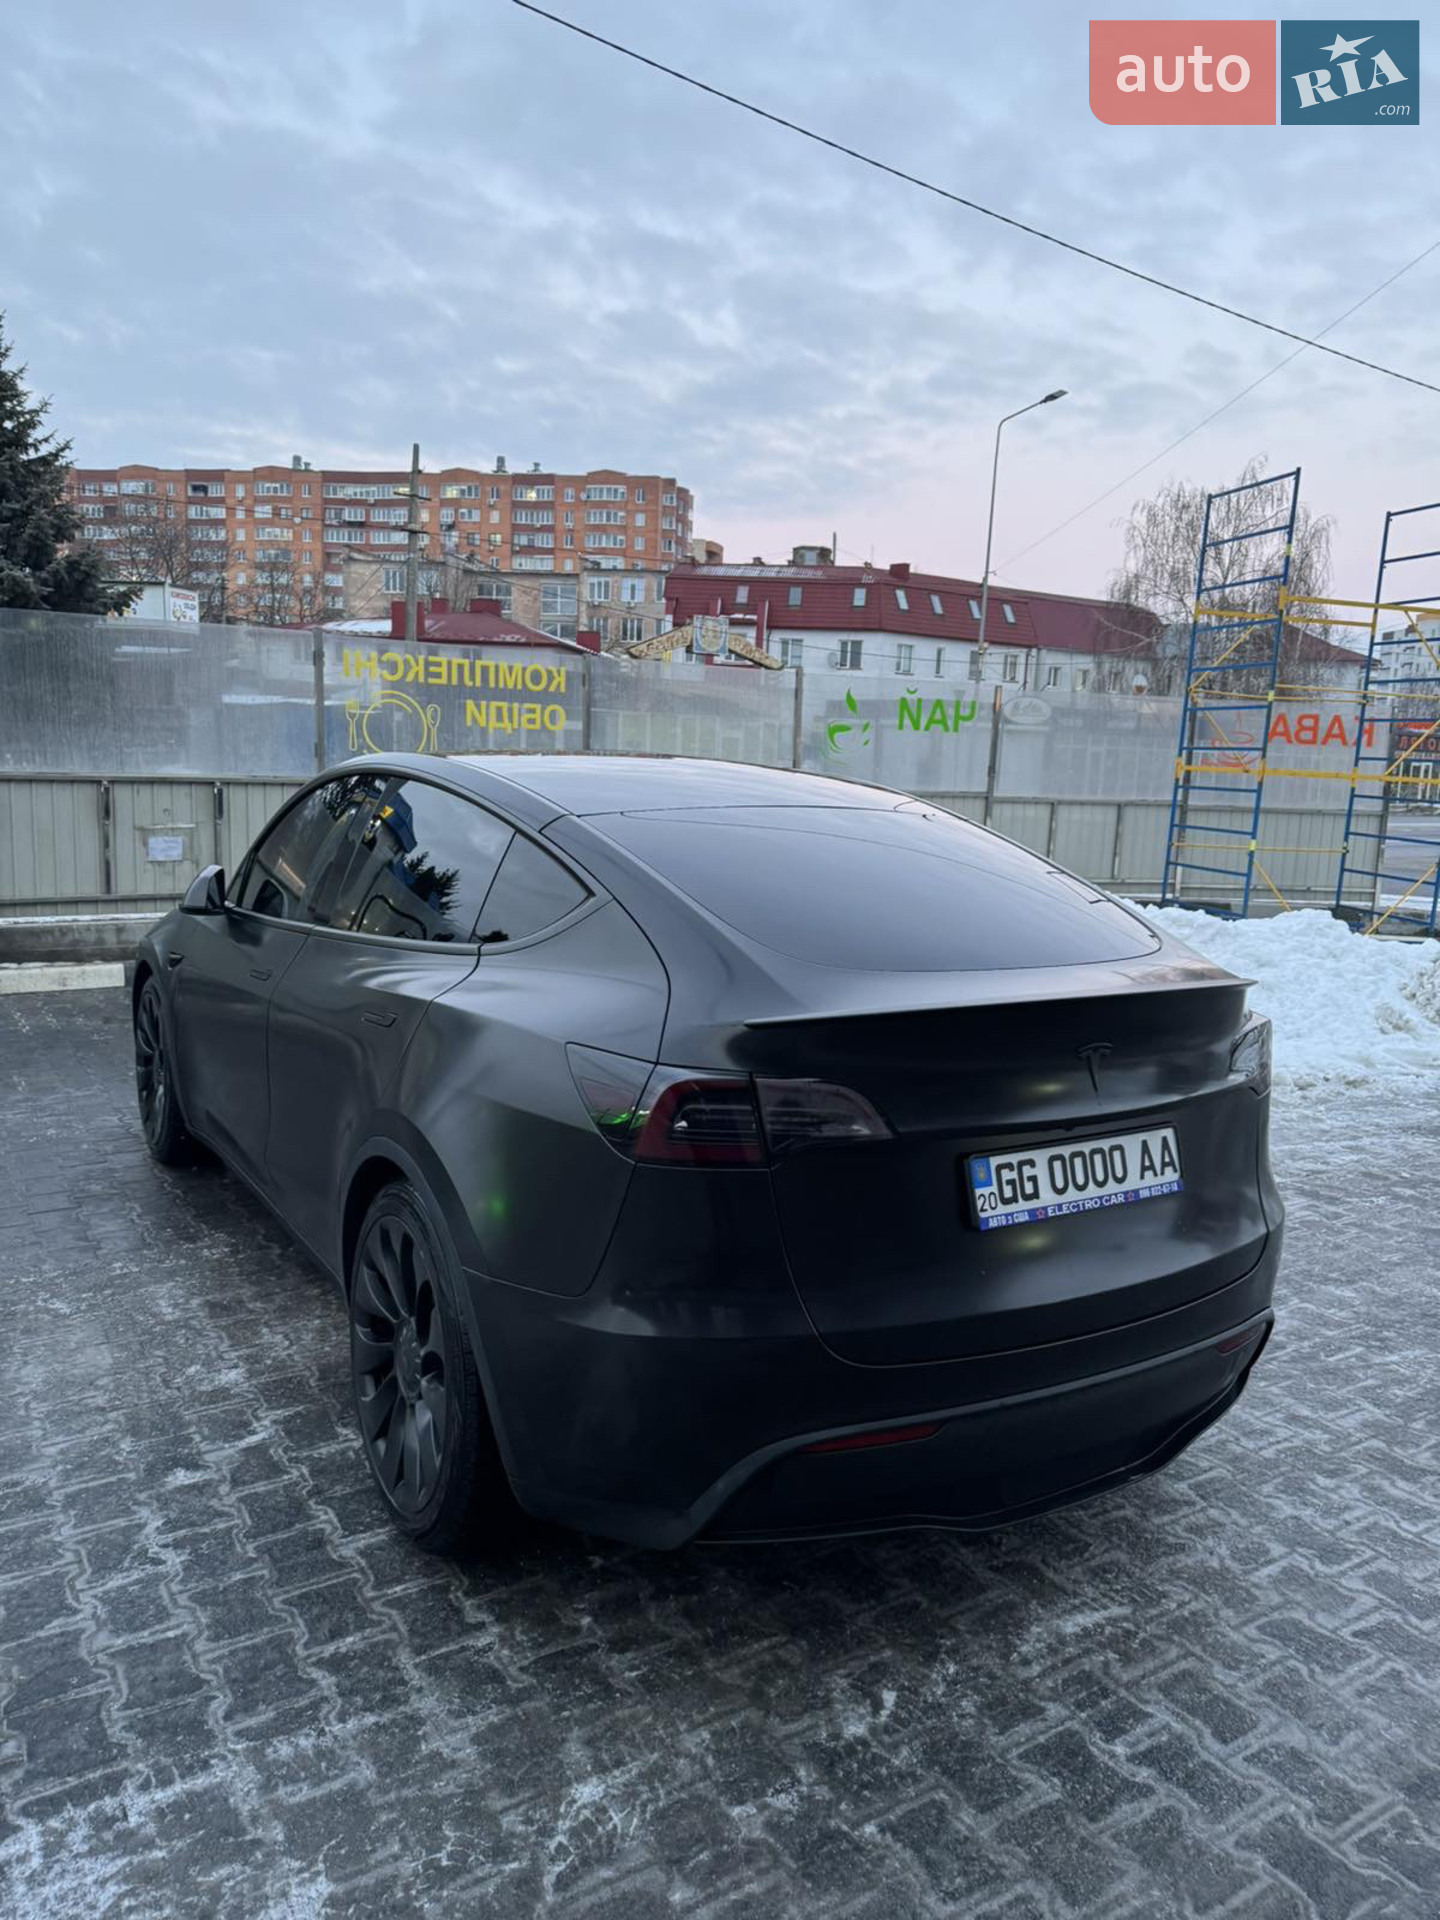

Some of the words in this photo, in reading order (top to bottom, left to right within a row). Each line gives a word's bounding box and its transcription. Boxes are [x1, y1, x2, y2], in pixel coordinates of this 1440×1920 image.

[995, 1157, 1041, 1206] GG
[1047, 1144, 1128, 1195] 0000
[1140, 1135, 1178, 1180] AA
[978, 1191, 998, 1213] 20
[1047, 1195, 1101, 1217] ELECTRO
[1103, 1193, 1125, 1207] CAR
